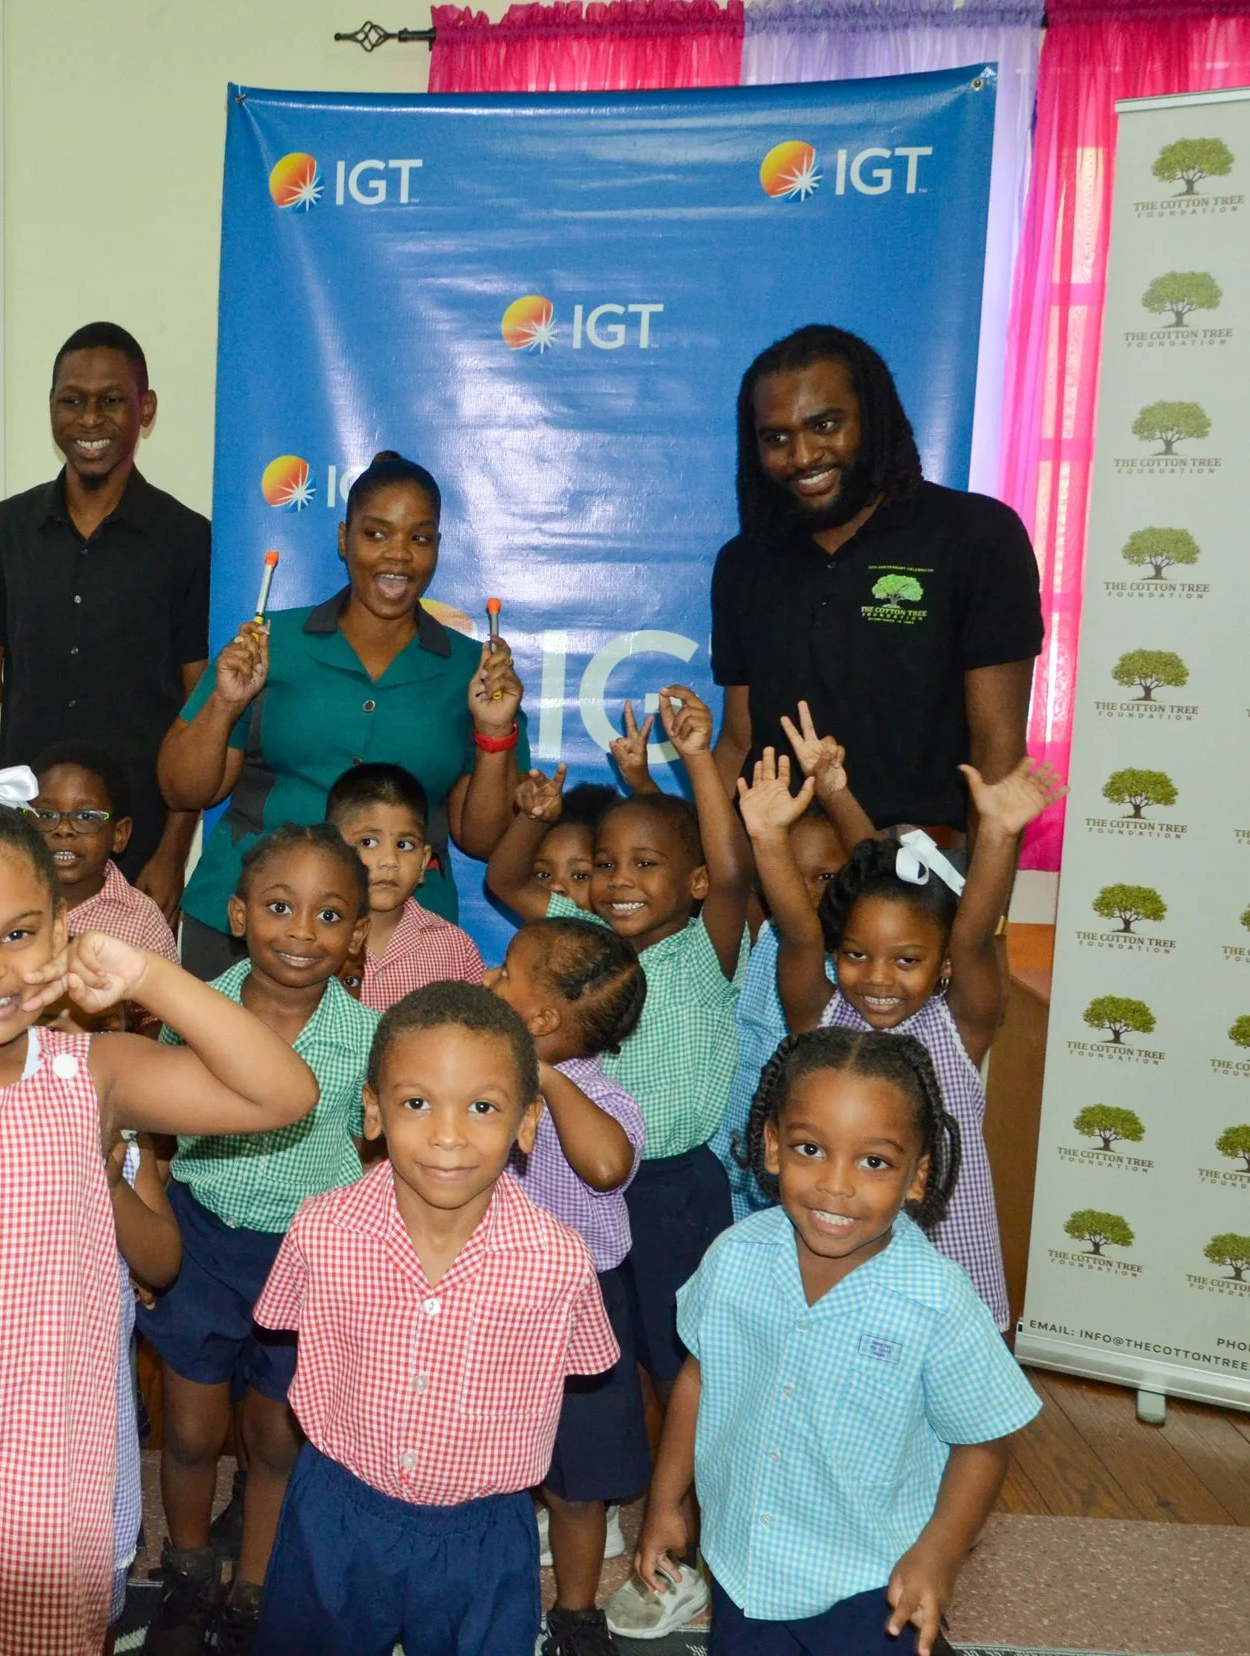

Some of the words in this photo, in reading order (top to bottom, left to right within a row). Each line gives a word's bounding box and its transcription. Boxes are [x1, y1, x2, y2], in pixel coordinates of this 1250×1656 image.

[835, 147, 933, 195] IGT
[336, 159, 423, 205] IGT
[1133, 201, 1158, 212] THE
[1160, 198, 1209, 210] COTTON
[1213, 195, 1246, 206] TREE
[1136, 206, 1238, 218] FOUNDATION
[573, 303, 664, 349] IGT
[1123, 331, 1148, 341] THE
[1150, 329, 1199, 341] COTTON
[1201, 328, 1234, 338] TREE
[1127, 339, 1227, 348] FOUNDATION
[1113, 458, 1138, 467] THE
[1140, 458, 1187, 467] COTTON
[1190, 458, 1222, 467] TREE
[1117, 467, 1215, 475] FOUNDATION
[1104, 582, 1127, 591] THE
[1130, 582, 1177, 592] COTTON
[1180, 583, 1210, 593] TREE
[1107, 591, 1204, 600] FOUNDATION
[875, 607, 906, 616] COTTON
[538, 629, 711, 764] IG
[1094, 701, 1117, 711] THE
[1120, 702, 1166, 713] COTTON
[1169, 705, 1199, 715] TREE
[1097, 711, 1193, 721] FOUNDATION
[1085, 818, 1107, 828] THE
[1110, 820, 1155, 831] COTTON
[1158, 823, 1188, 833] TREE
[1088, 827, 1182, 839] FOUNDATION
[1075, 931, 1097, 941] THE
[1100, 933, 1145, 945] COTTON
[1147, 937, 1178, 949] TREE
[1078, 940, 1171, 954] FOUNDATION
[1222, 945, 1246, 956] THE
[1066, 1041, 1088, 1051] THE
[1090, 1043, 1134, 1056] COTTON
[1136, 1048, 1166, 1061] TREE
[1069, 1050, 1159, 1066] FOUNDATION
[1210, 1059, 1234, 1069] THE
[1057, 1146, 1079, 1157] THE
[1080, 1150, 1124, 1164] COTTON
[1126, 1156, 1155, 1169] TREE
[1059, 1156, 1149, 1174] FOUNDATION
[1198, 1168, 1221, 1179] THE
[1048, 1249, 1069, 1260] THE
[1070, 1253, 1114, 1268] COTTON
[1115, 1261, 1144, 1273] TREE
[1050, 1258, 1138, 1278] FOUNDATION
[1186, 1274, 1208, 1285] THE
[1190, 1283, 1250, 1298] FOUNDA
[1029, 1320, 1075, 1336] EMAIL:
[1217, 1337, 1250, 1352] PHO
